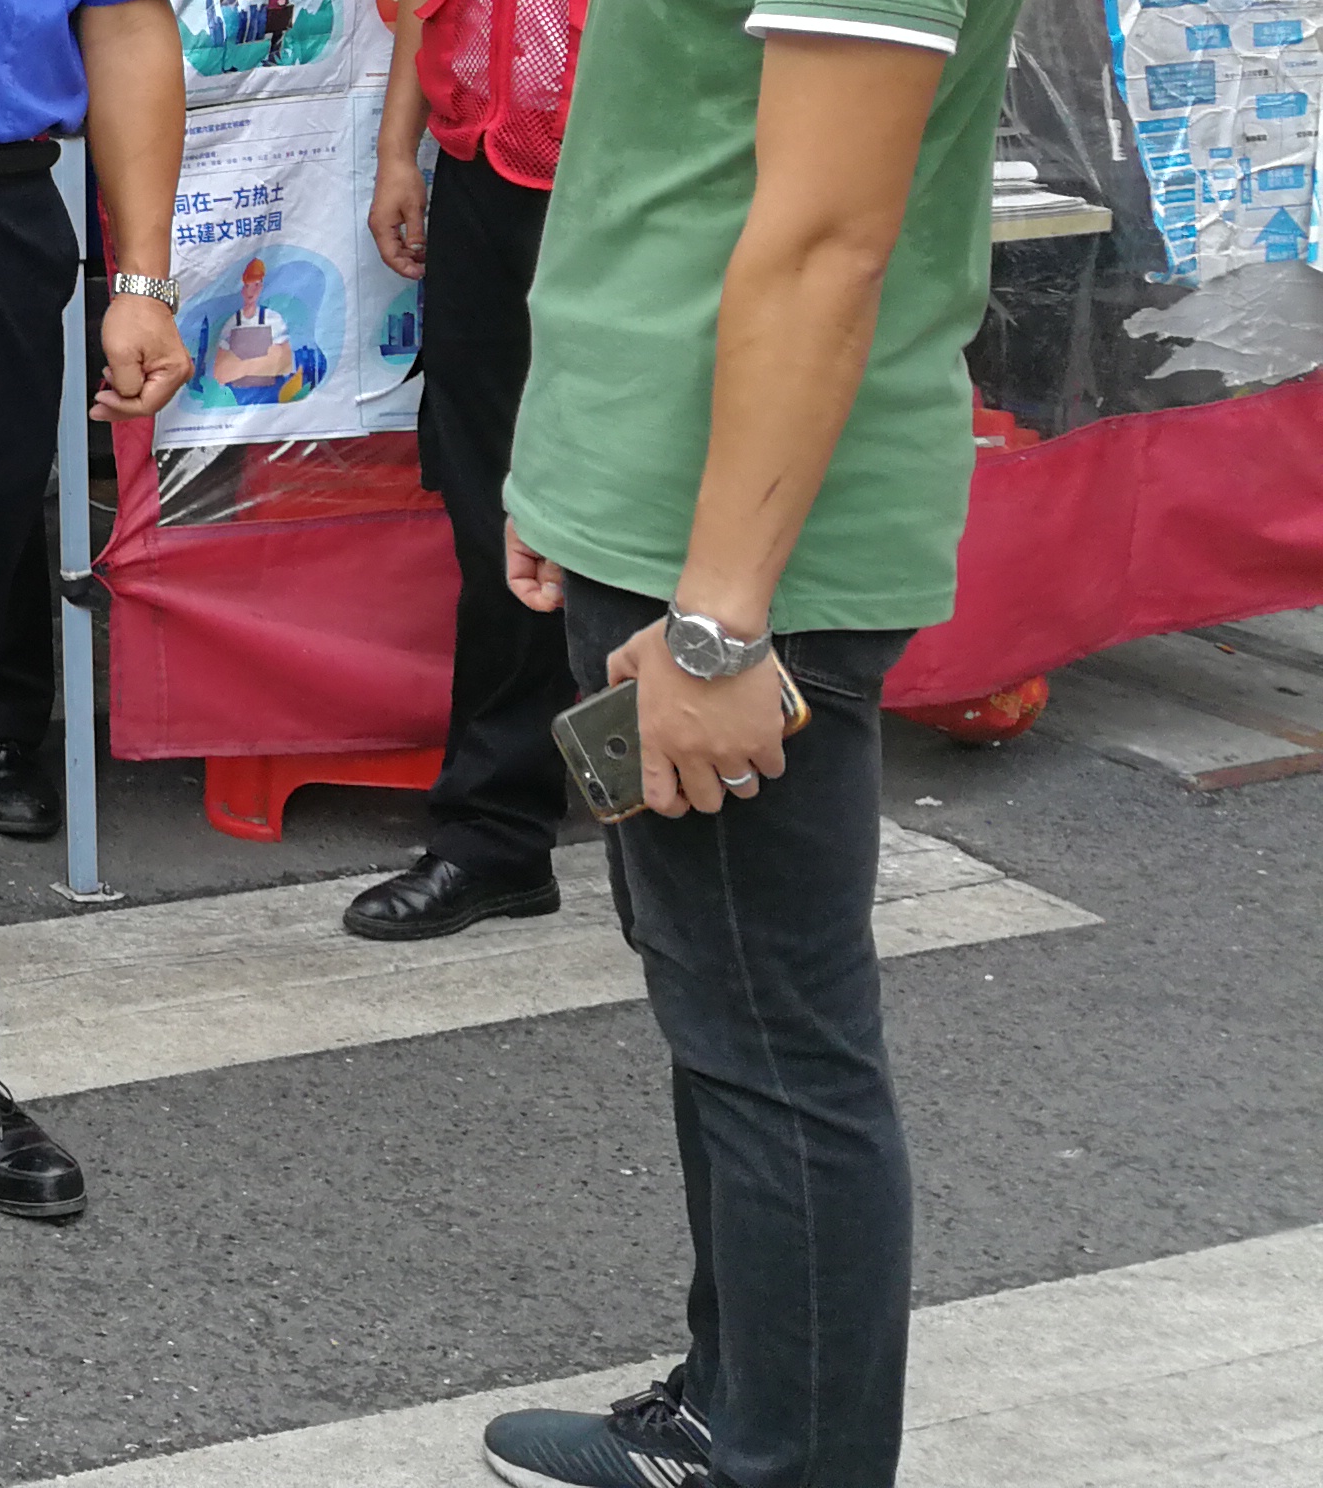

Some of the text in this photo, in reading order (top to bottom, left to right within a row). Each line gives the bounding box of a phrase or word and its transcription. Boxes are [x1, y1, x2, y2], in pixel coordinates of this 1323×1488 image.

[174, 183, 284, 215] 同在一方热土
[176, 211, 282, 246] 共建文明家园
